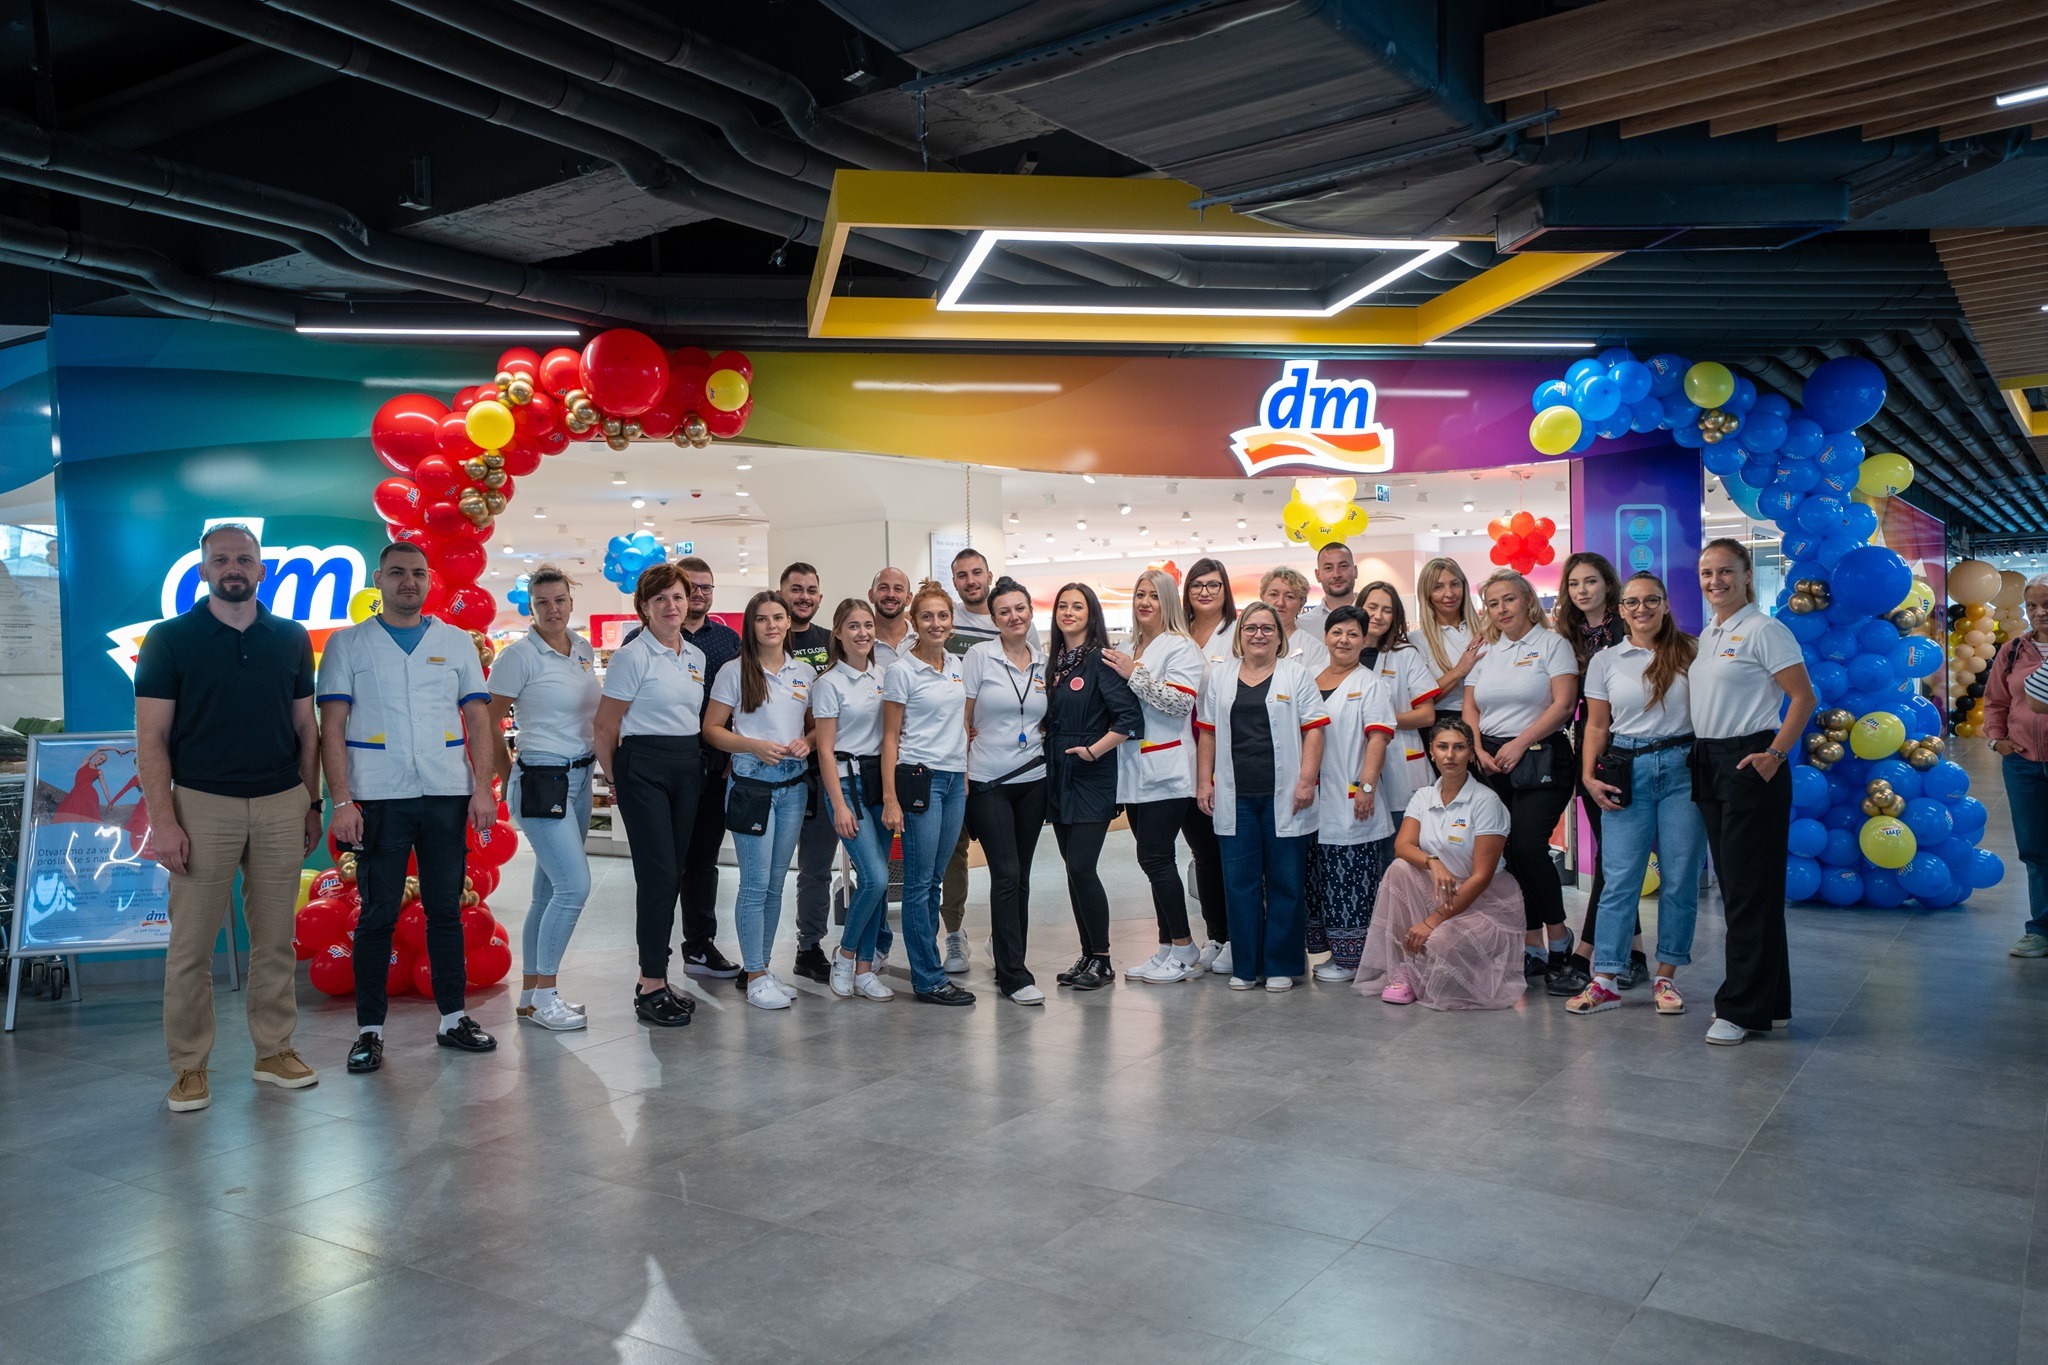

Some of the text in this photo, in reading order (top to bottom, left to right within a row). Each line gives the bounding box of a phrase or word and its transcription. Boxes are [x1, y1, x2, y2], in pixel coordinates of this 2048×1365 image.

[1268, 368, 1368, 429] dm
[369, 599, 379, 613] dm
[808, 647, 827, 655] CLOSE
[1866, 718, 1880, 727] dm
[1886, 829, 1901, 837] dm
[86, 847, 97, 855] za
[37, 857, 83, 867] proslaite
[321, 878, 339, 889] dm
[146, 910, 166, 921] dm
